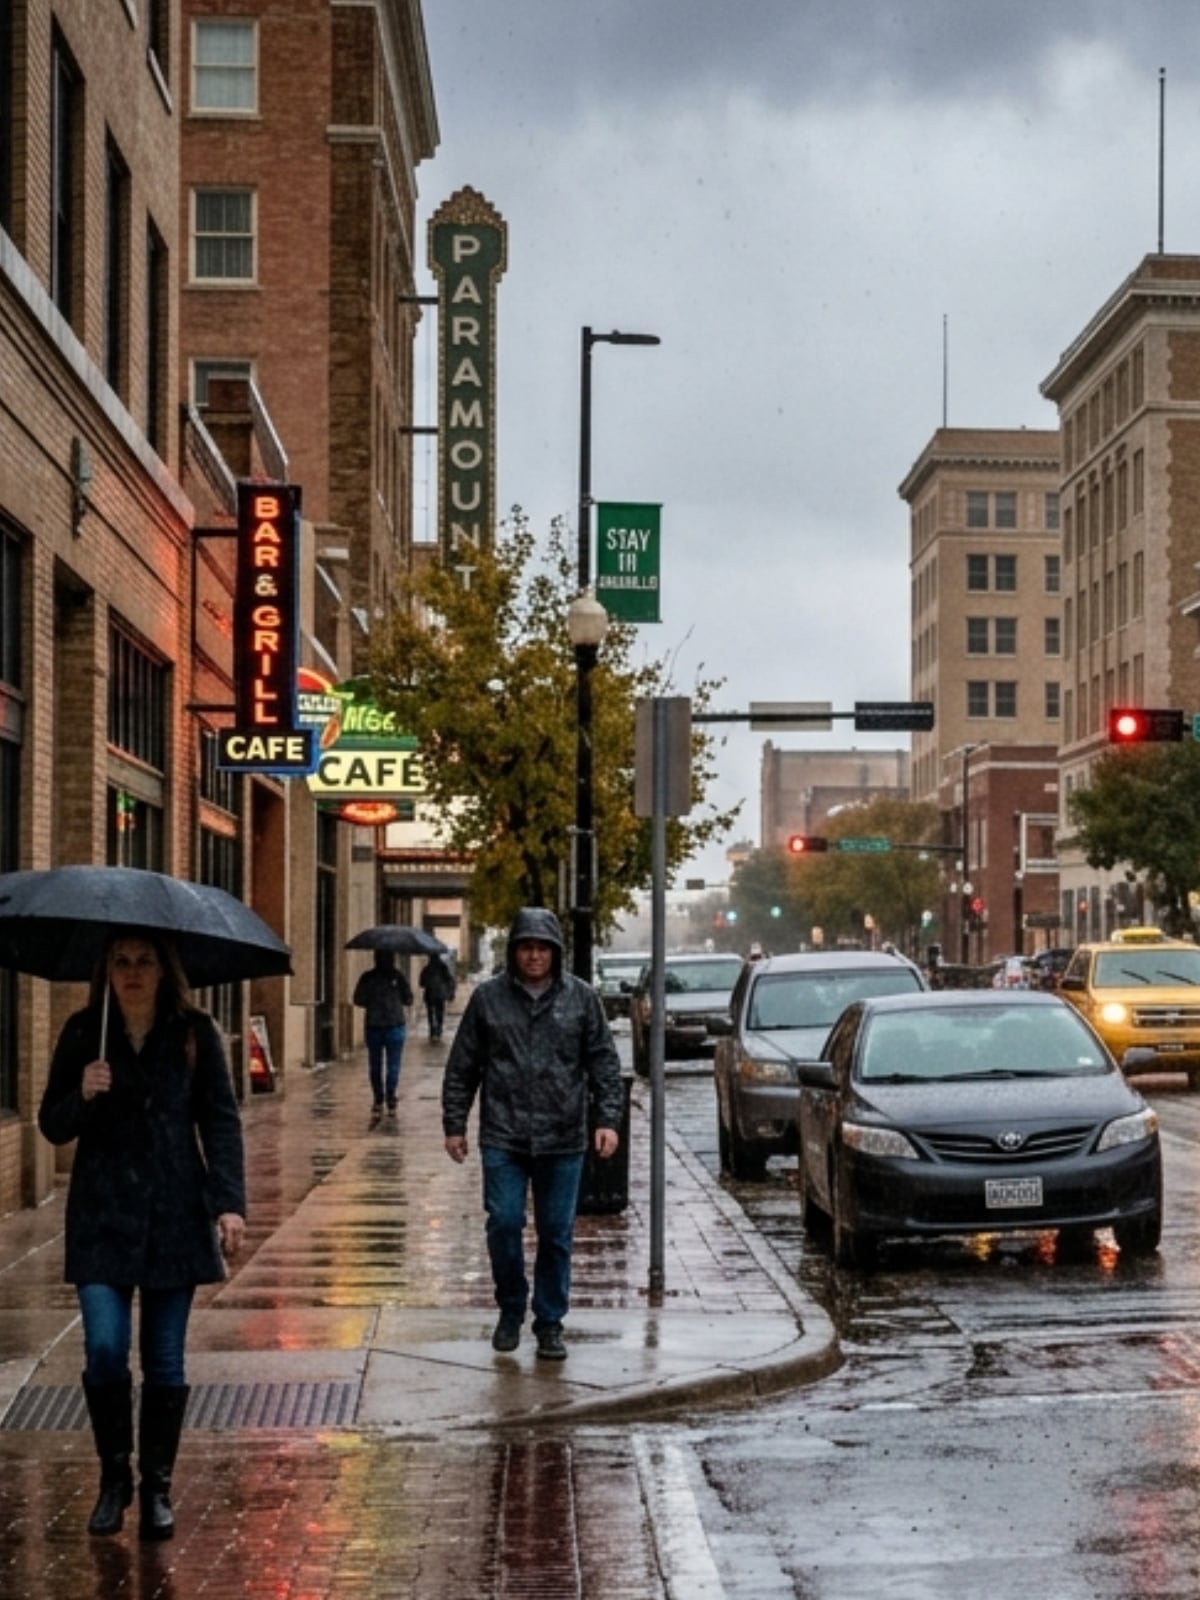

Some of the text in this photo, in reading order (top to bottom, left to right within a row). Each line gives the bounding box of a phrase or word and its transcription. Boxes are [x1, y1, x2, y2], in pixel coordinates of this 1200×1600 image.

[450, 234, 485, 592] PARAMOUNT
[606, 528, 651, 552] STAY
[252, 496, 281, 724] BAR & GRILL
[226, 735, 305, 761] CAFE
